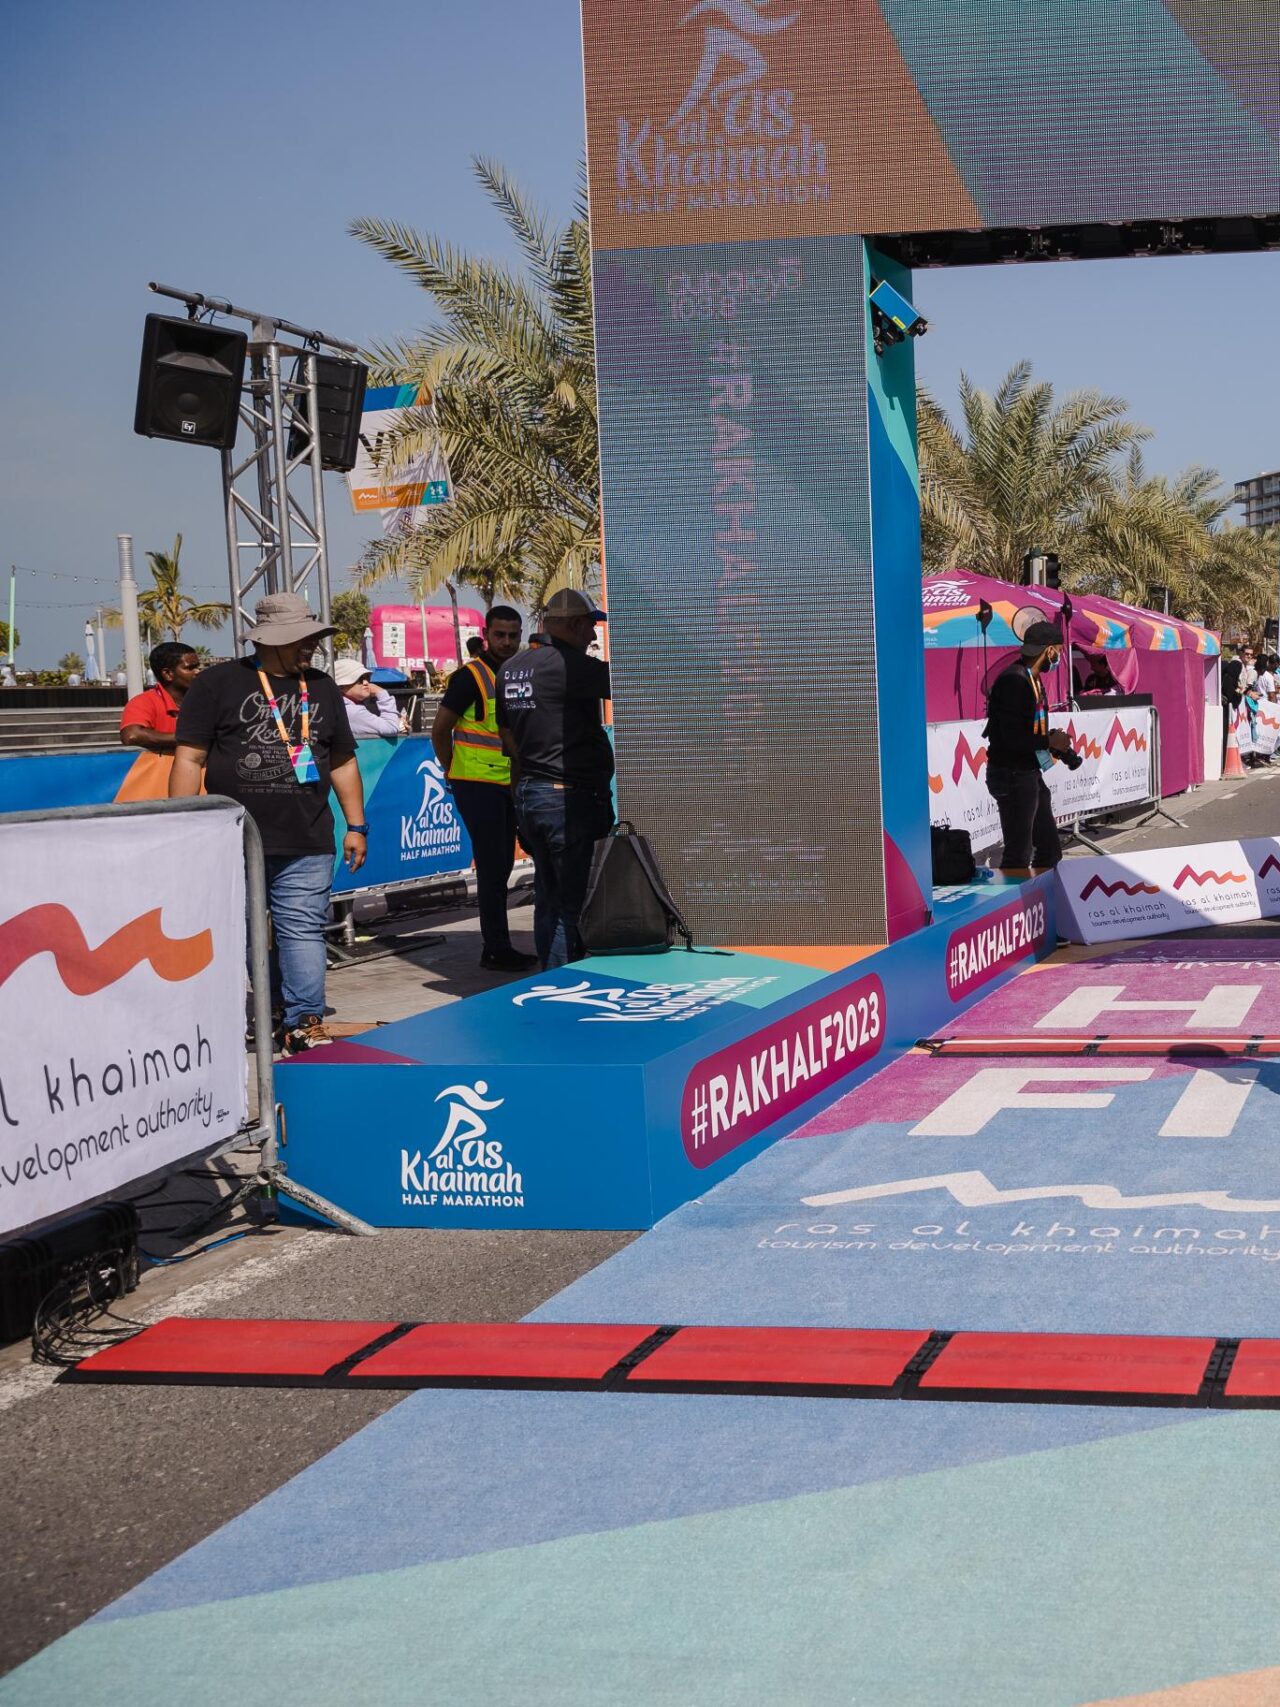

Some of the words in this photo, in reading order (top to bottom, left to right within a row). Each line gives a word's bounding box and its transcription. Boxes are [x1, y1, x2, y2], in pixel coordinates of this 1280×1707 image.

[616, 115, 830, 190] Khaimah
[419, 810, 429, 829] al
[401, 815, 461, 850] Khaimah
[400, 850, 420, 861] HALF
[421, 844, 461, 858] MARATHON
[1181, 898, 1198, 906] ras
[1201, 894, 1210, 904] al
[1213, 890, 1253, 902] khaimah
[1265, 886, 1280, 895] ras
[1088, 909, 1105, 918] ras
[1110, 906, 1121, 917] al
[1124, 901, 1167, 915] khaimah
[1091, 918, 1111, 928] tourism
[1110, 914, 1148, 926] development
[1146, 911, 1171, 923] authority
[950, 901, 1045, 989] #RAKHALF2023
[44, 1024, 213, 1114] khaimah
[691, 990, 881, 1149] #RAKHALF2023
[136, 1088, 214, 1138] authority
[435, 1146, 454, 1169] al
[401, 1148, 524, 1194] Khaimah
[402, 1193, 438, 1206] HALF
[442, 1194, 525, 1208] MARATHON
[773, 1222, 877, 1235] ras
[911, 1220, 970, 1236] al
[757, 1239, 877, 1251] tourism
[888, 1239, 1114, 1256] development
